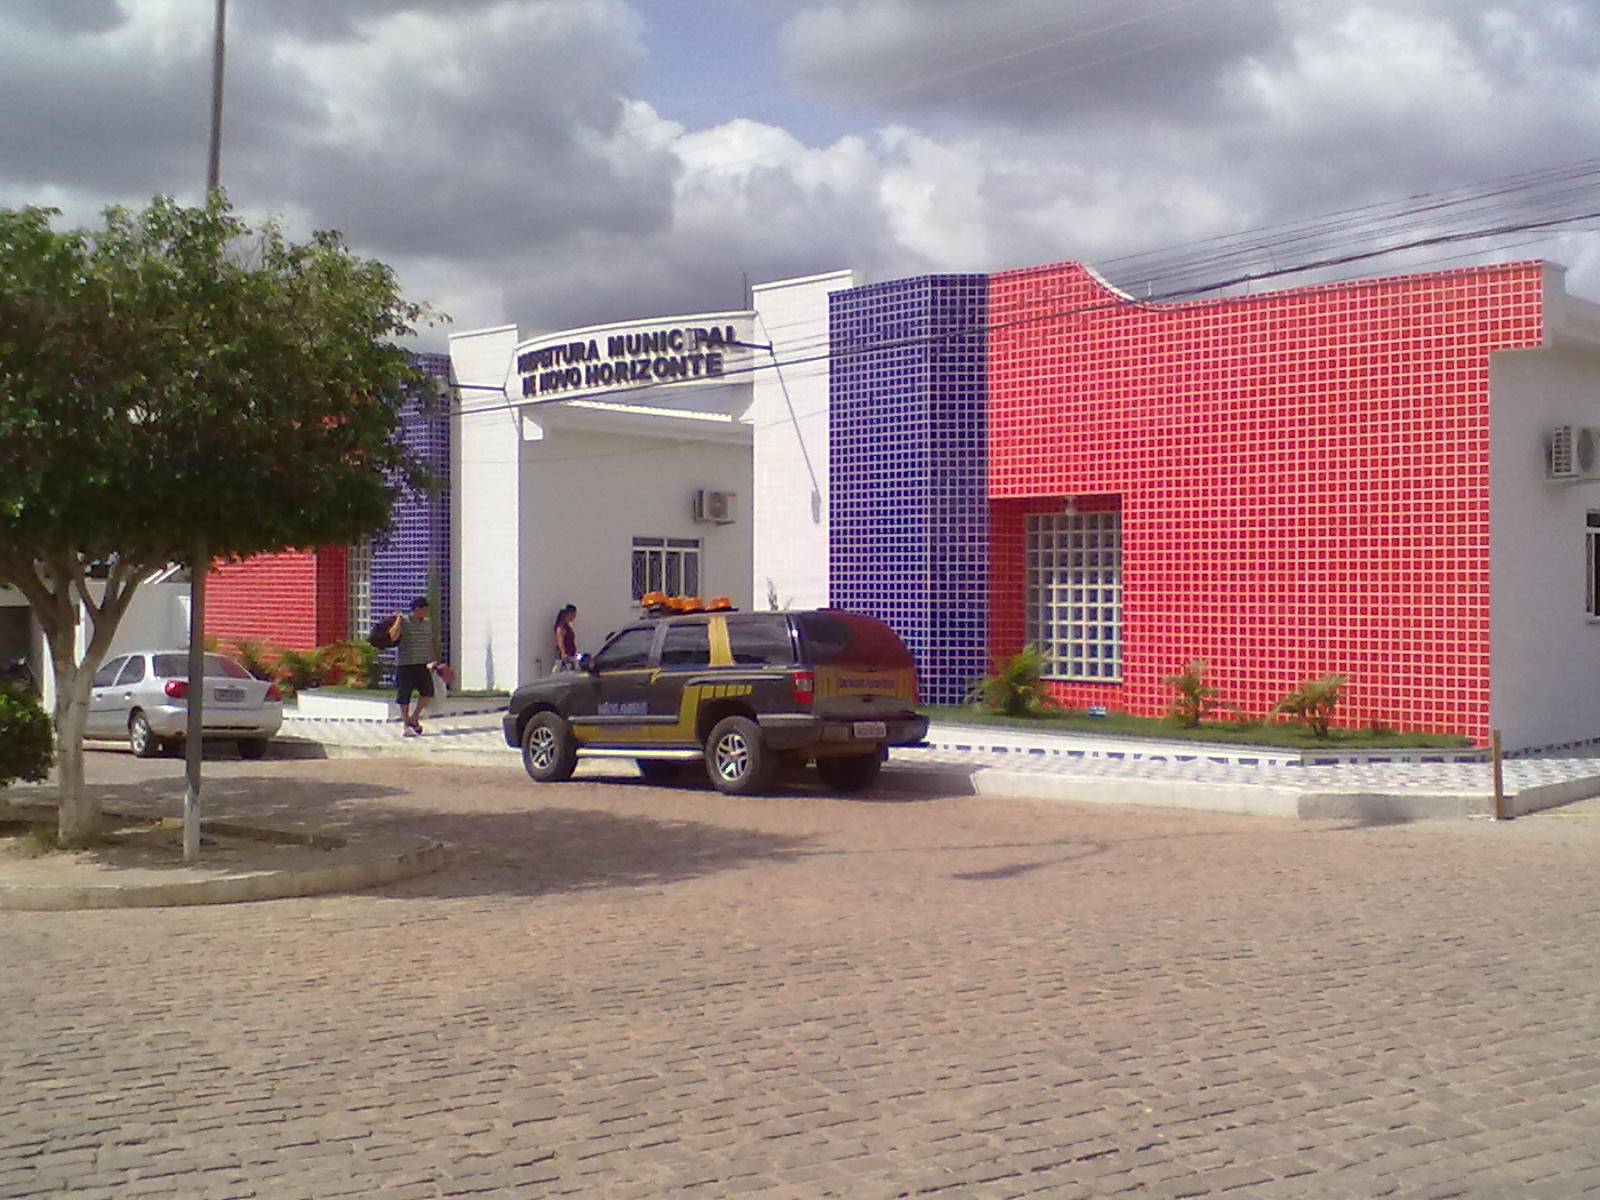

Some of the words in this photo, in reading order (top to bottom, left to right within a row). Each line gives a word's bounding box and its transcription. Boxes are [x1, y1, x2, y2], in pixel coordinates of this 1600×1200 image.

[607, 326, 738, 355] MUNICIPAL
[539, 367, 582, 393] NOVO
[585, 353, 722, 386] HORIZONTE
